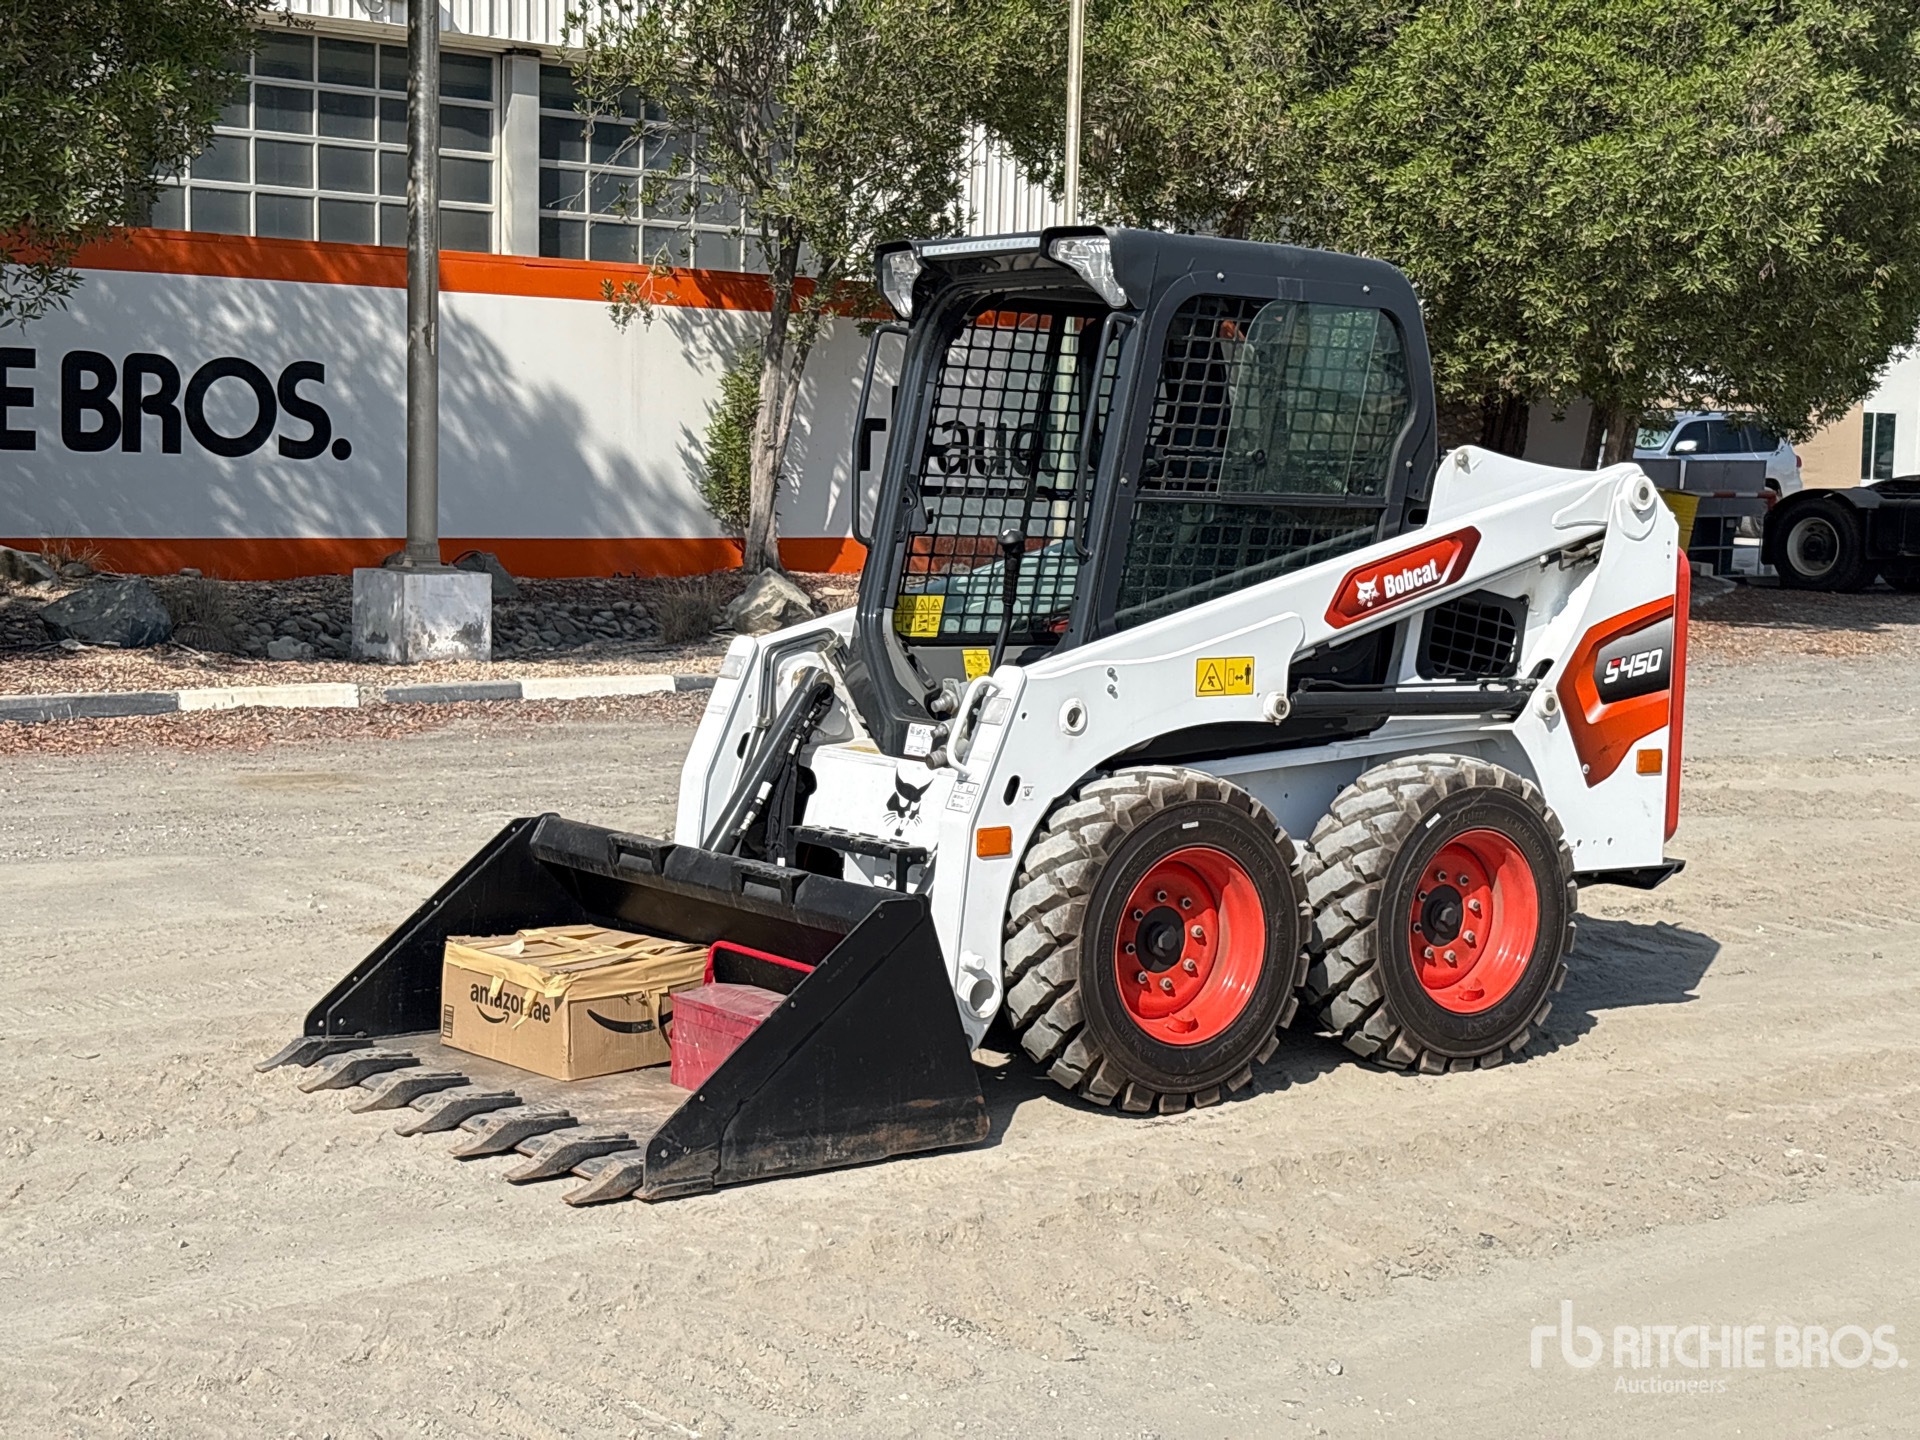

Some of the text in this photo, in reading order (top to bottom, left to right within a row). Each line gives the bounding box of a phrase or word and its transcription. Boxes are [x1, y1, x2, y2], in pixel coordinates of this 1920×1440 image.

[61, 350, 352, 460] BROS.
[1383, 558, 1438, 599] Bobcat
[1603, 648, 1663, 685] S450
